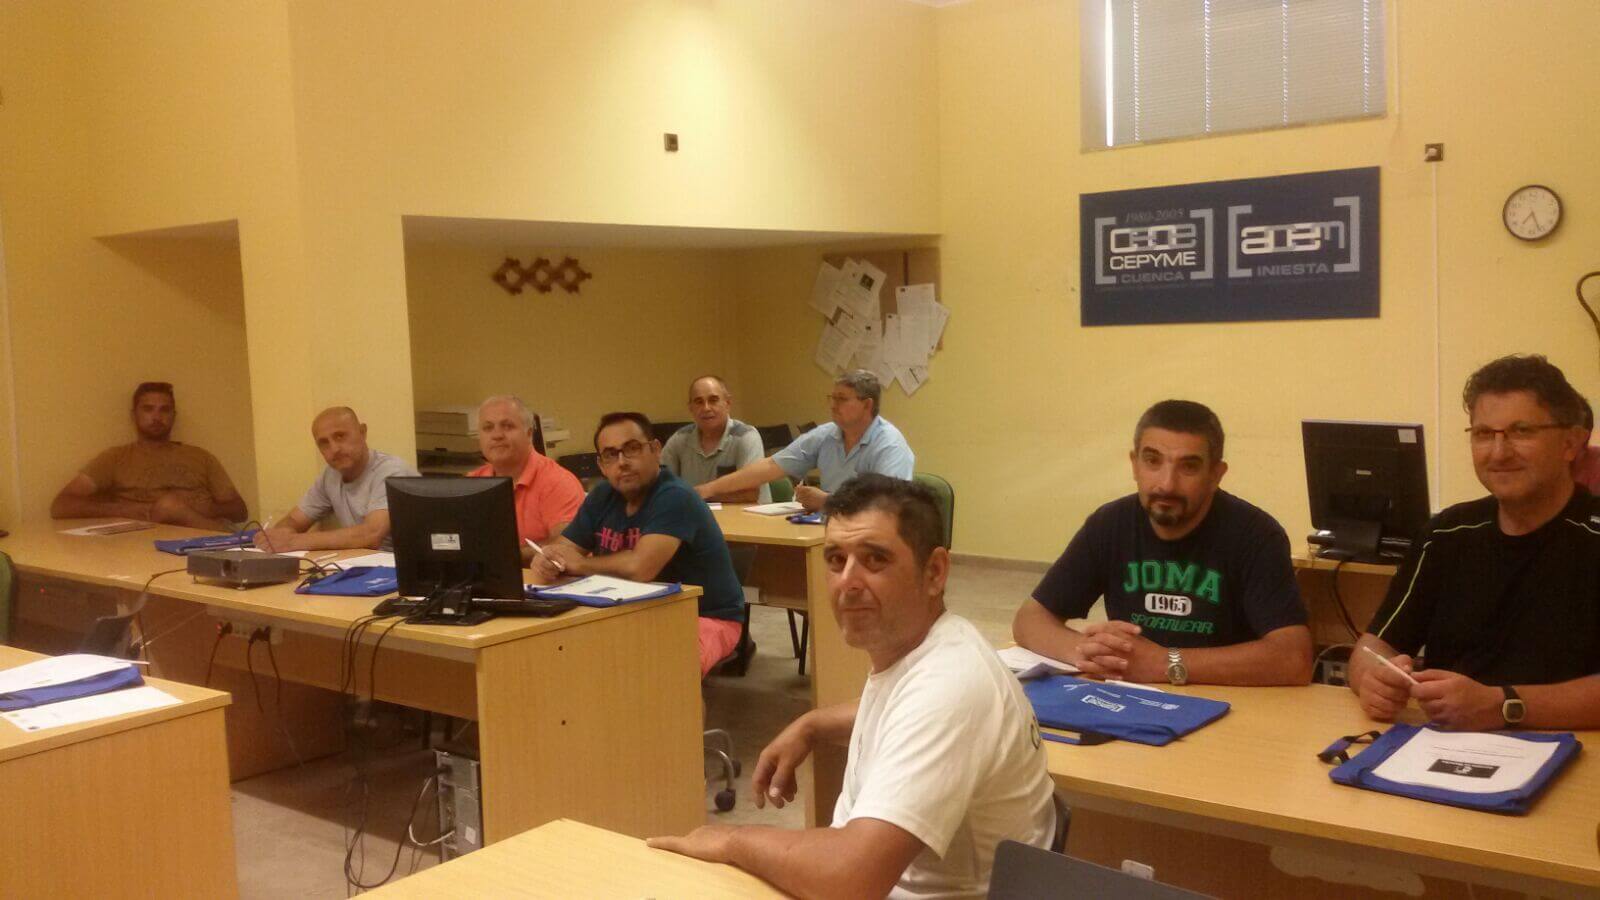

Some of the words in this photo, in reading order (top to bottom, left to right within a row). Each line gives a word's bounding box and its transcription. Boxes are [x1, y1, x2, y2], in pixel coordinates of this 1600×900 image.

[1109, 250, 1197, 271] CEPYME
[1256, 262, 1331, 277] INIESTA
[1120, 270, 1186, 284] CUENCA
[1122, 560, 1221, 605] JOMA
[1150, 594, 1187, 614] 1965
